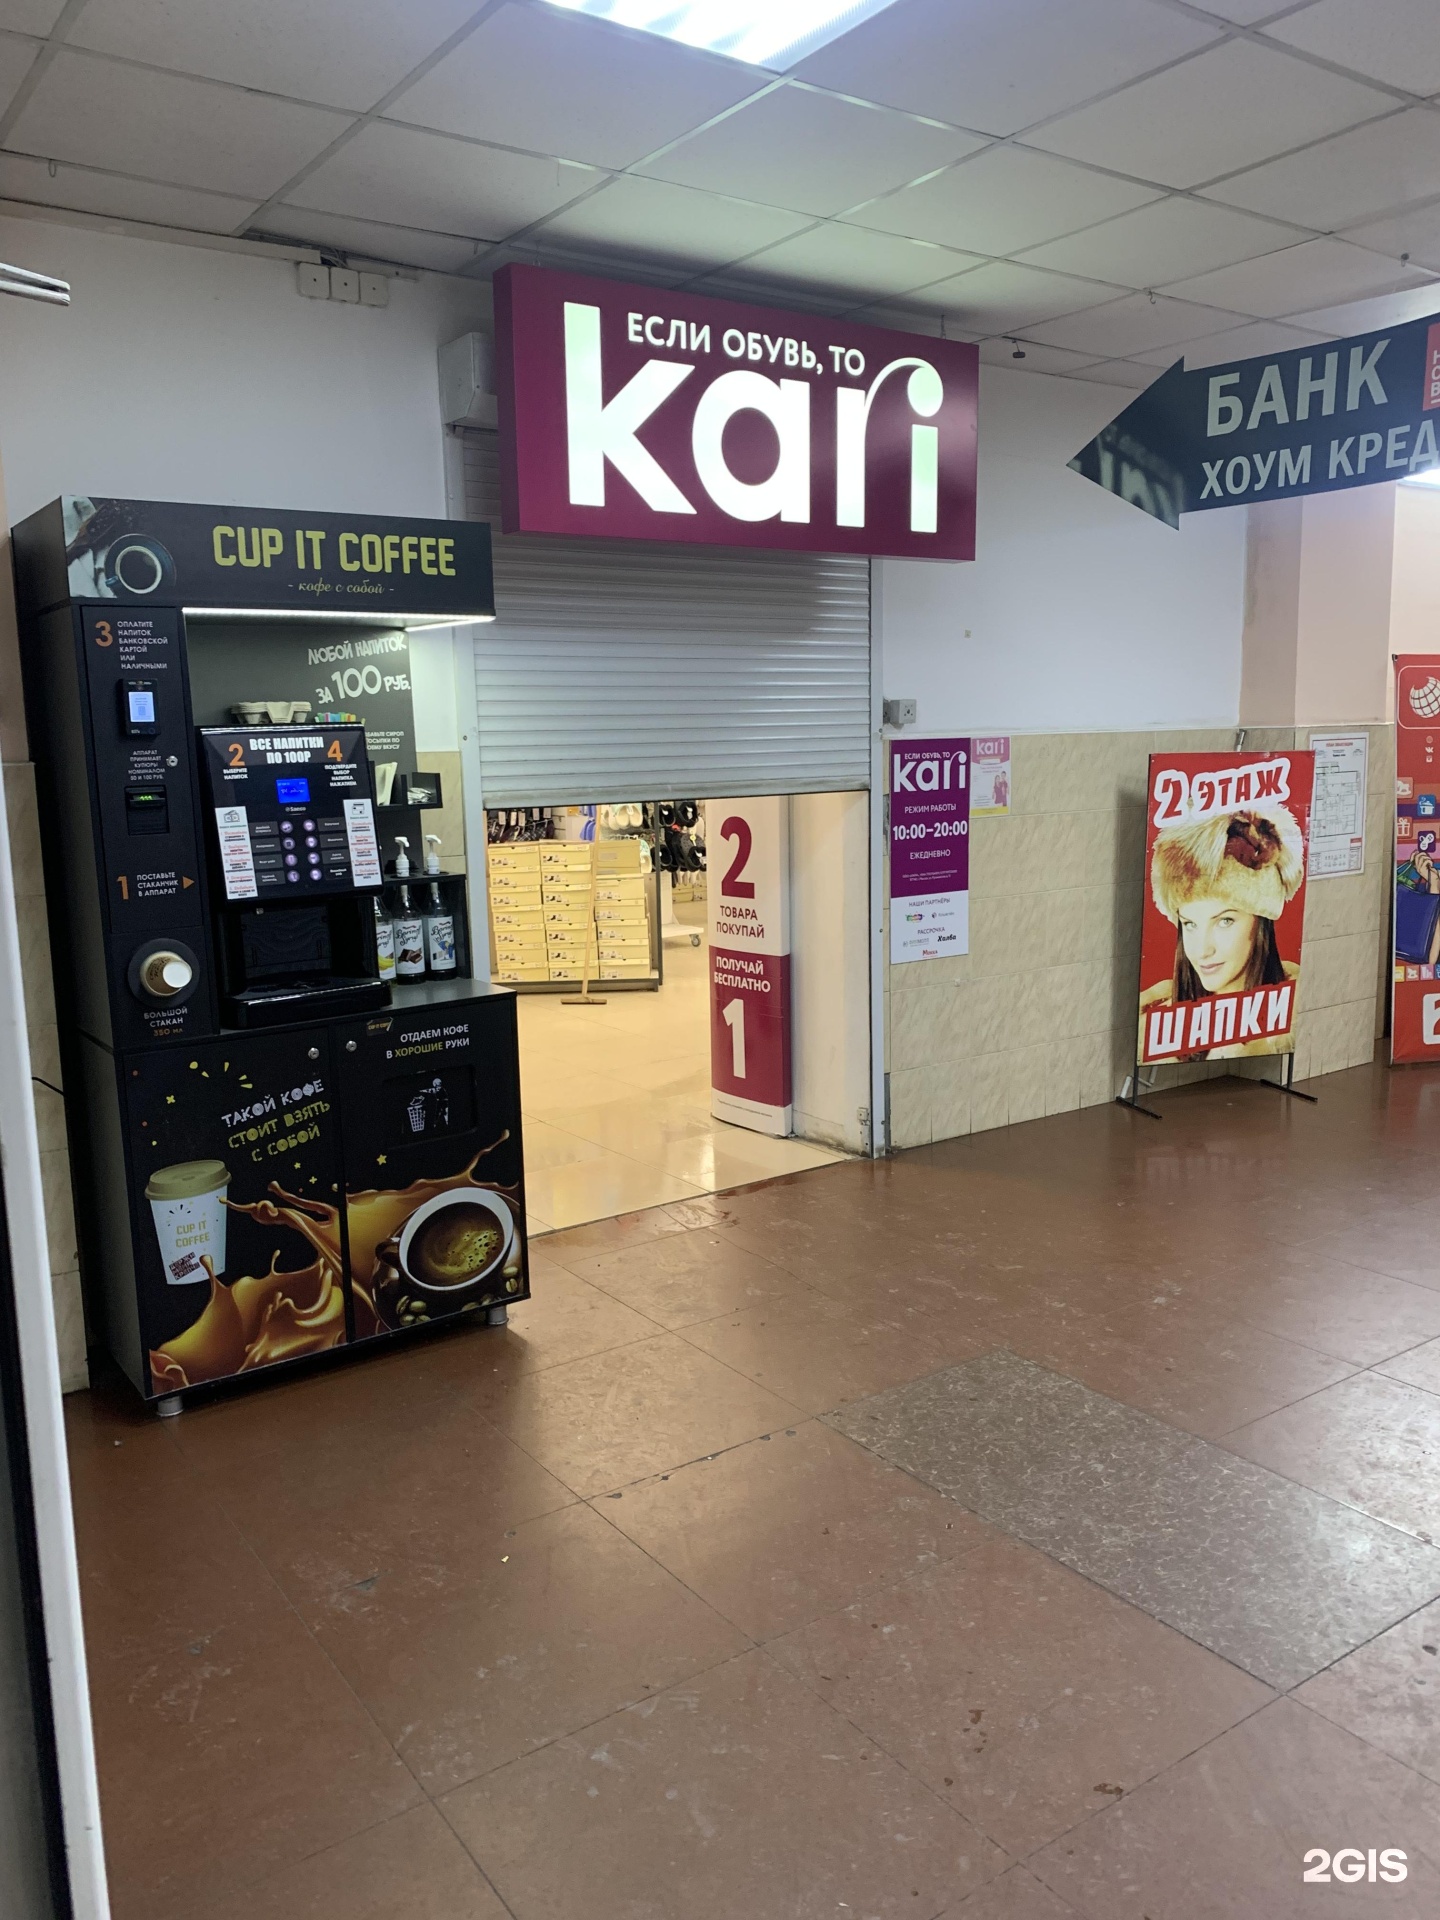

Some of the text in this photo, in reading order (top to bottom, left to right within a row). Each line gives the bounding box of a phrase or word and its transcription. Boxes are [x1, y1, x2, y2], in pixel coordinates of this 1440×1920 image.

[627, 311, 866, 377] ЕСЛИ ОБУВЬ, ТО
[1207, 338, 1392, 438] БАНК
[564, 302, 944, 533] kari
[1200, 445, 1313, 500] ХОУМ
[1328, 418, 1440, 480] КРЕД
[212, 525, 456, 576] CUP IT COFFEE
[298, 577, 385, 597] кофе с собой
[95, 620, 114, 647] 3
[117, 620, 154, 628] ОПЛАТИТЕ
[118, 636, 169, 645] БАНКОВСКОЙ
[119, 645, 148, 653] КАРТОЙ
[308, 634, 407, 666] ЛЮБОЙ НАПИТОК
[121, 662, 168, 670] НАЛИЧНЫМИ
[315, 664, 411, 705] ЗА 100 РУБ.
[249, 736, 325, 751] ВСЕ НАПИТКИ
[327, 739, 343, 762] 4
[976, 738, 1005, 756] kari
[228, 743, 246, 767] 2
[266, 750, 312, 764] ПО 100Р
[904, 752, 920, 760] ЕСЛИ
[128, 767, 166, 775] НОМИНАЛОМ
[893, 751, 968, 793] kari
[1161, 765, 1283, 820] 2 ЭТАЖ
[904, 802, 957, 814] РЕЖИМ РАБОТЫ
[719, 815, 756, 900] 2
[909, 848, 951, 860] ЕЖЕДНЕВНО
[136, 871, 176, 881] ПОСТАВЬТЕ
[137, 879, 179, 889] СТАКАНЧИК
[116, 875, 129, 900] 1
[144, 887, 177, 897] АППАРАТ
[719, 904, 759, 921] ТОВАРА
[716, 921, 765, 939] ПОКУПАЙ
[917, 926, 946, 935] РАССРОЧКА
[715, 955, 764, 976] ПОЛУЧАЙ
[713, 969, 771, 994] БЕСПЛАТНО
[144, 1006, 188, 1020] БОЛЬШОЙ
[150, 1017, 183, 1028] СТАКАН
[1148, 985, 1292, 1057] ШАПКИ
[153, 1028, 170, 1037] 350
[400, 1023, 470, 1043] ОТДАЕМ КОФЕ
[721, 998, 747, 1080] 1
[386, 1037, 470, 1059] В ХОРОШИЕ РУКИ
[221, 1078, 325, 1128] ТАКОЙ КОФЕ
[228, 1100, 331, 1149] СТОИТ ВЗЯТЬ
[251, 1121, 321, 1162] С СОБОЙ
[176, 1219, 207, 1235] CUP IT
[175, 1231, 211, 1248] COFFEE
